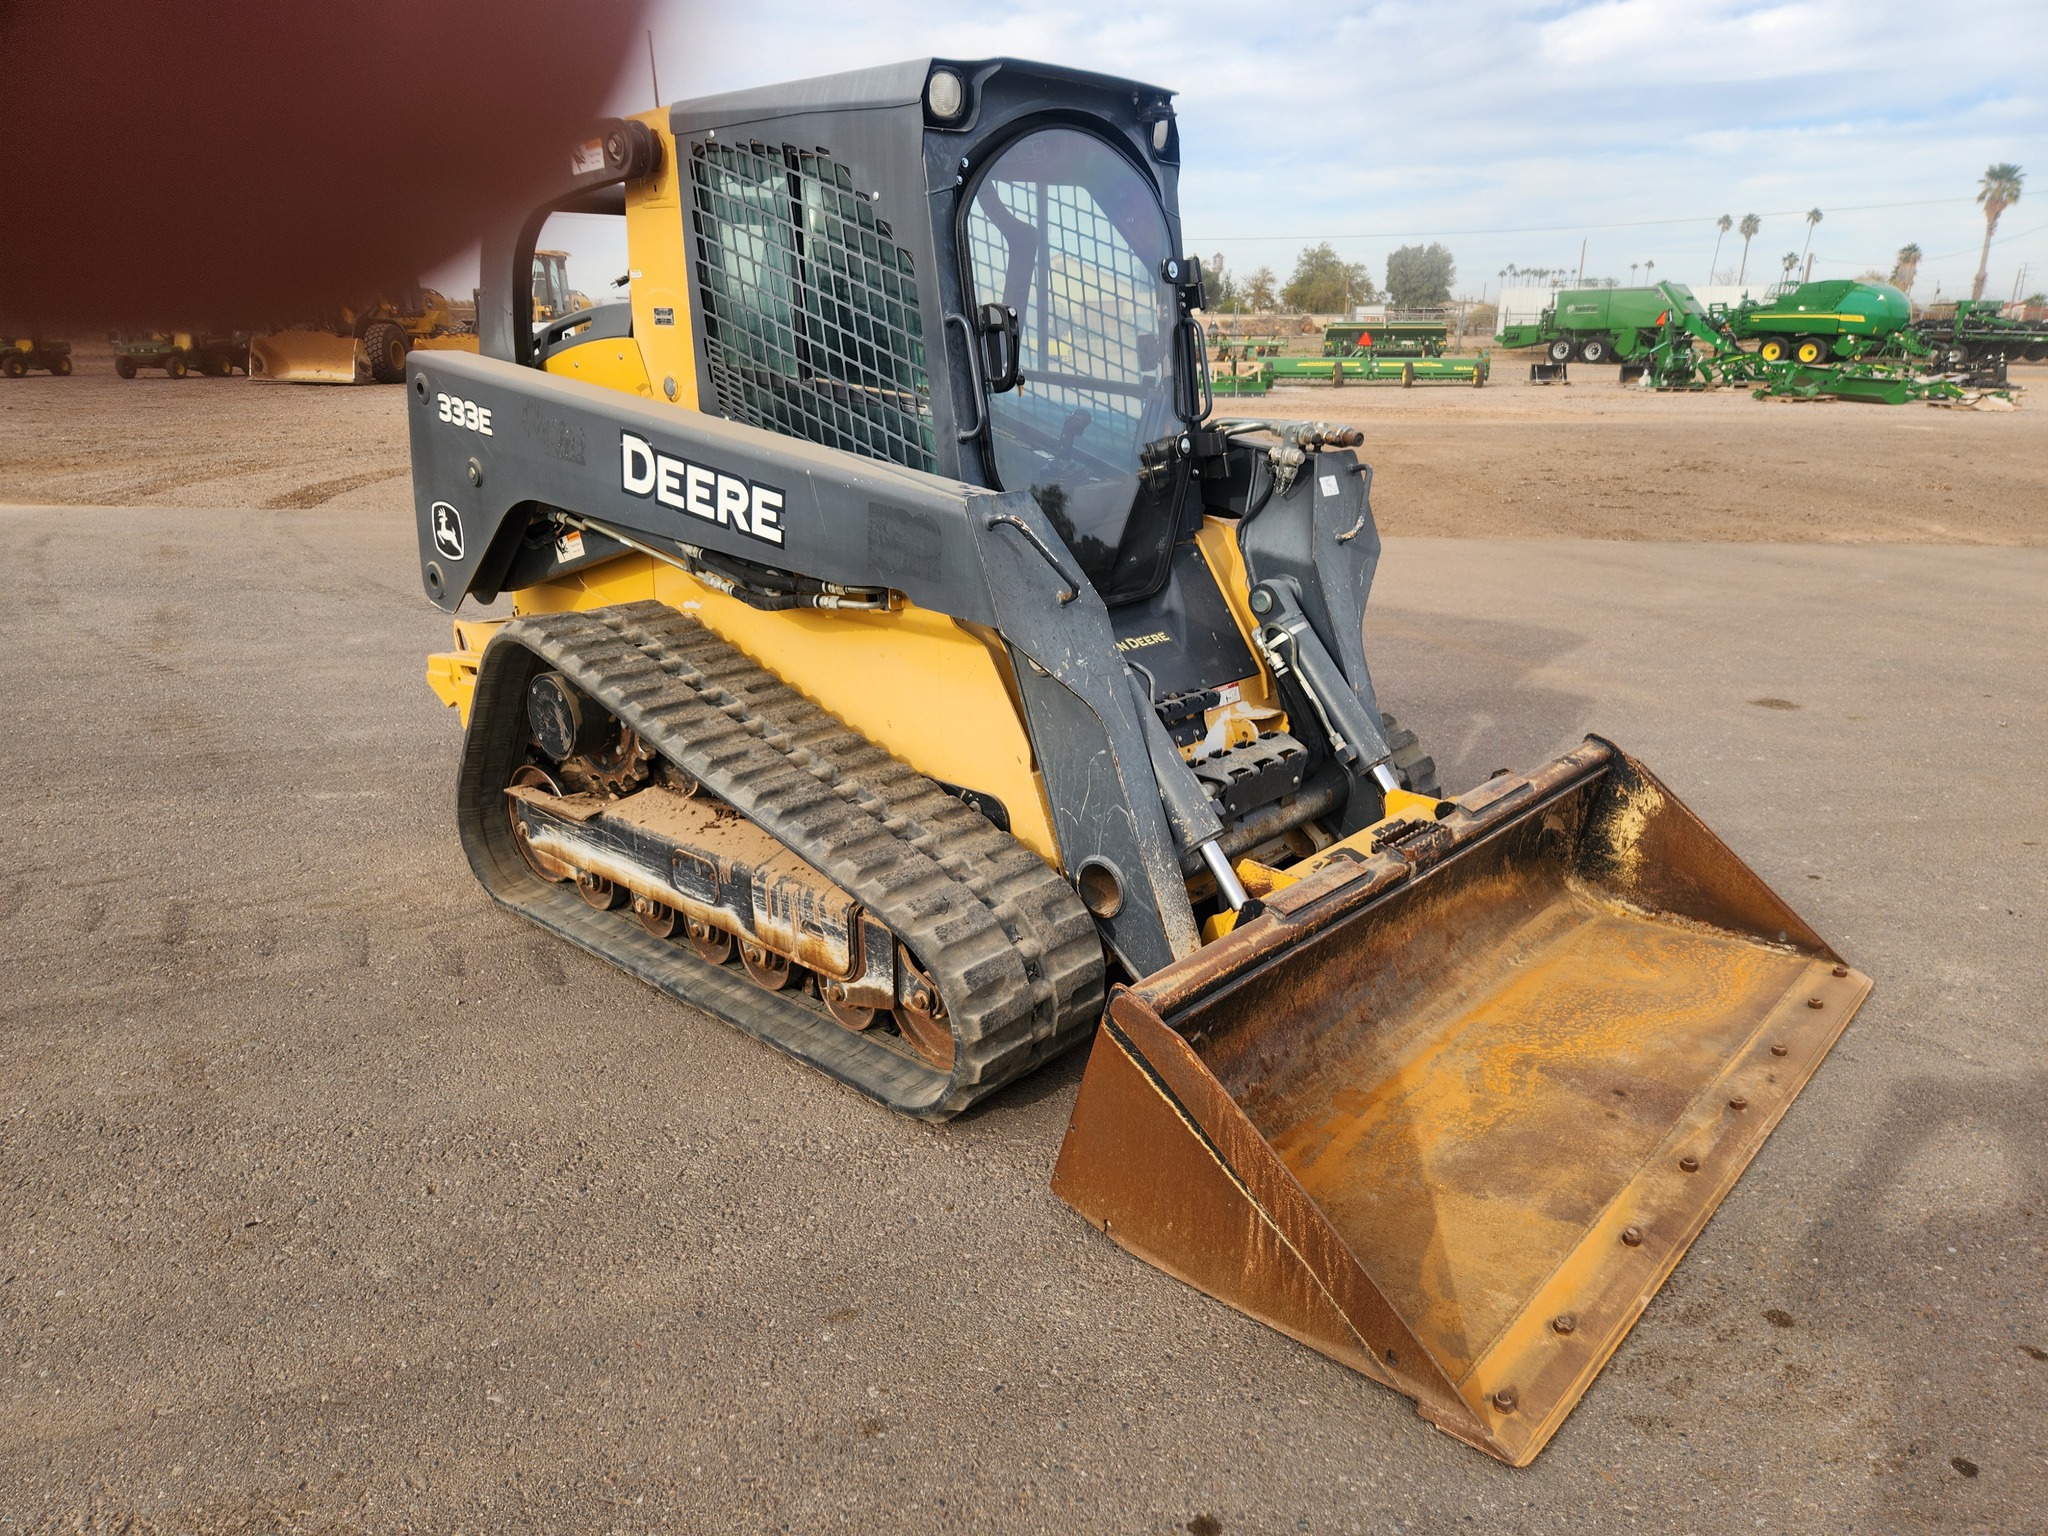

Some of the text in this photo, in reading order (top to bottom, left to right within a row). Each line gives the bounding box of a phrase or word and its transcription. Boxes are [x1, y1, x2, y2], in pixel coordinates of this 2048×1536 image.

[437, 392, 494, 436] 333E
[621, 432, 784, 544] DEERE
[1124, 631, 1170, 649] DEERE
